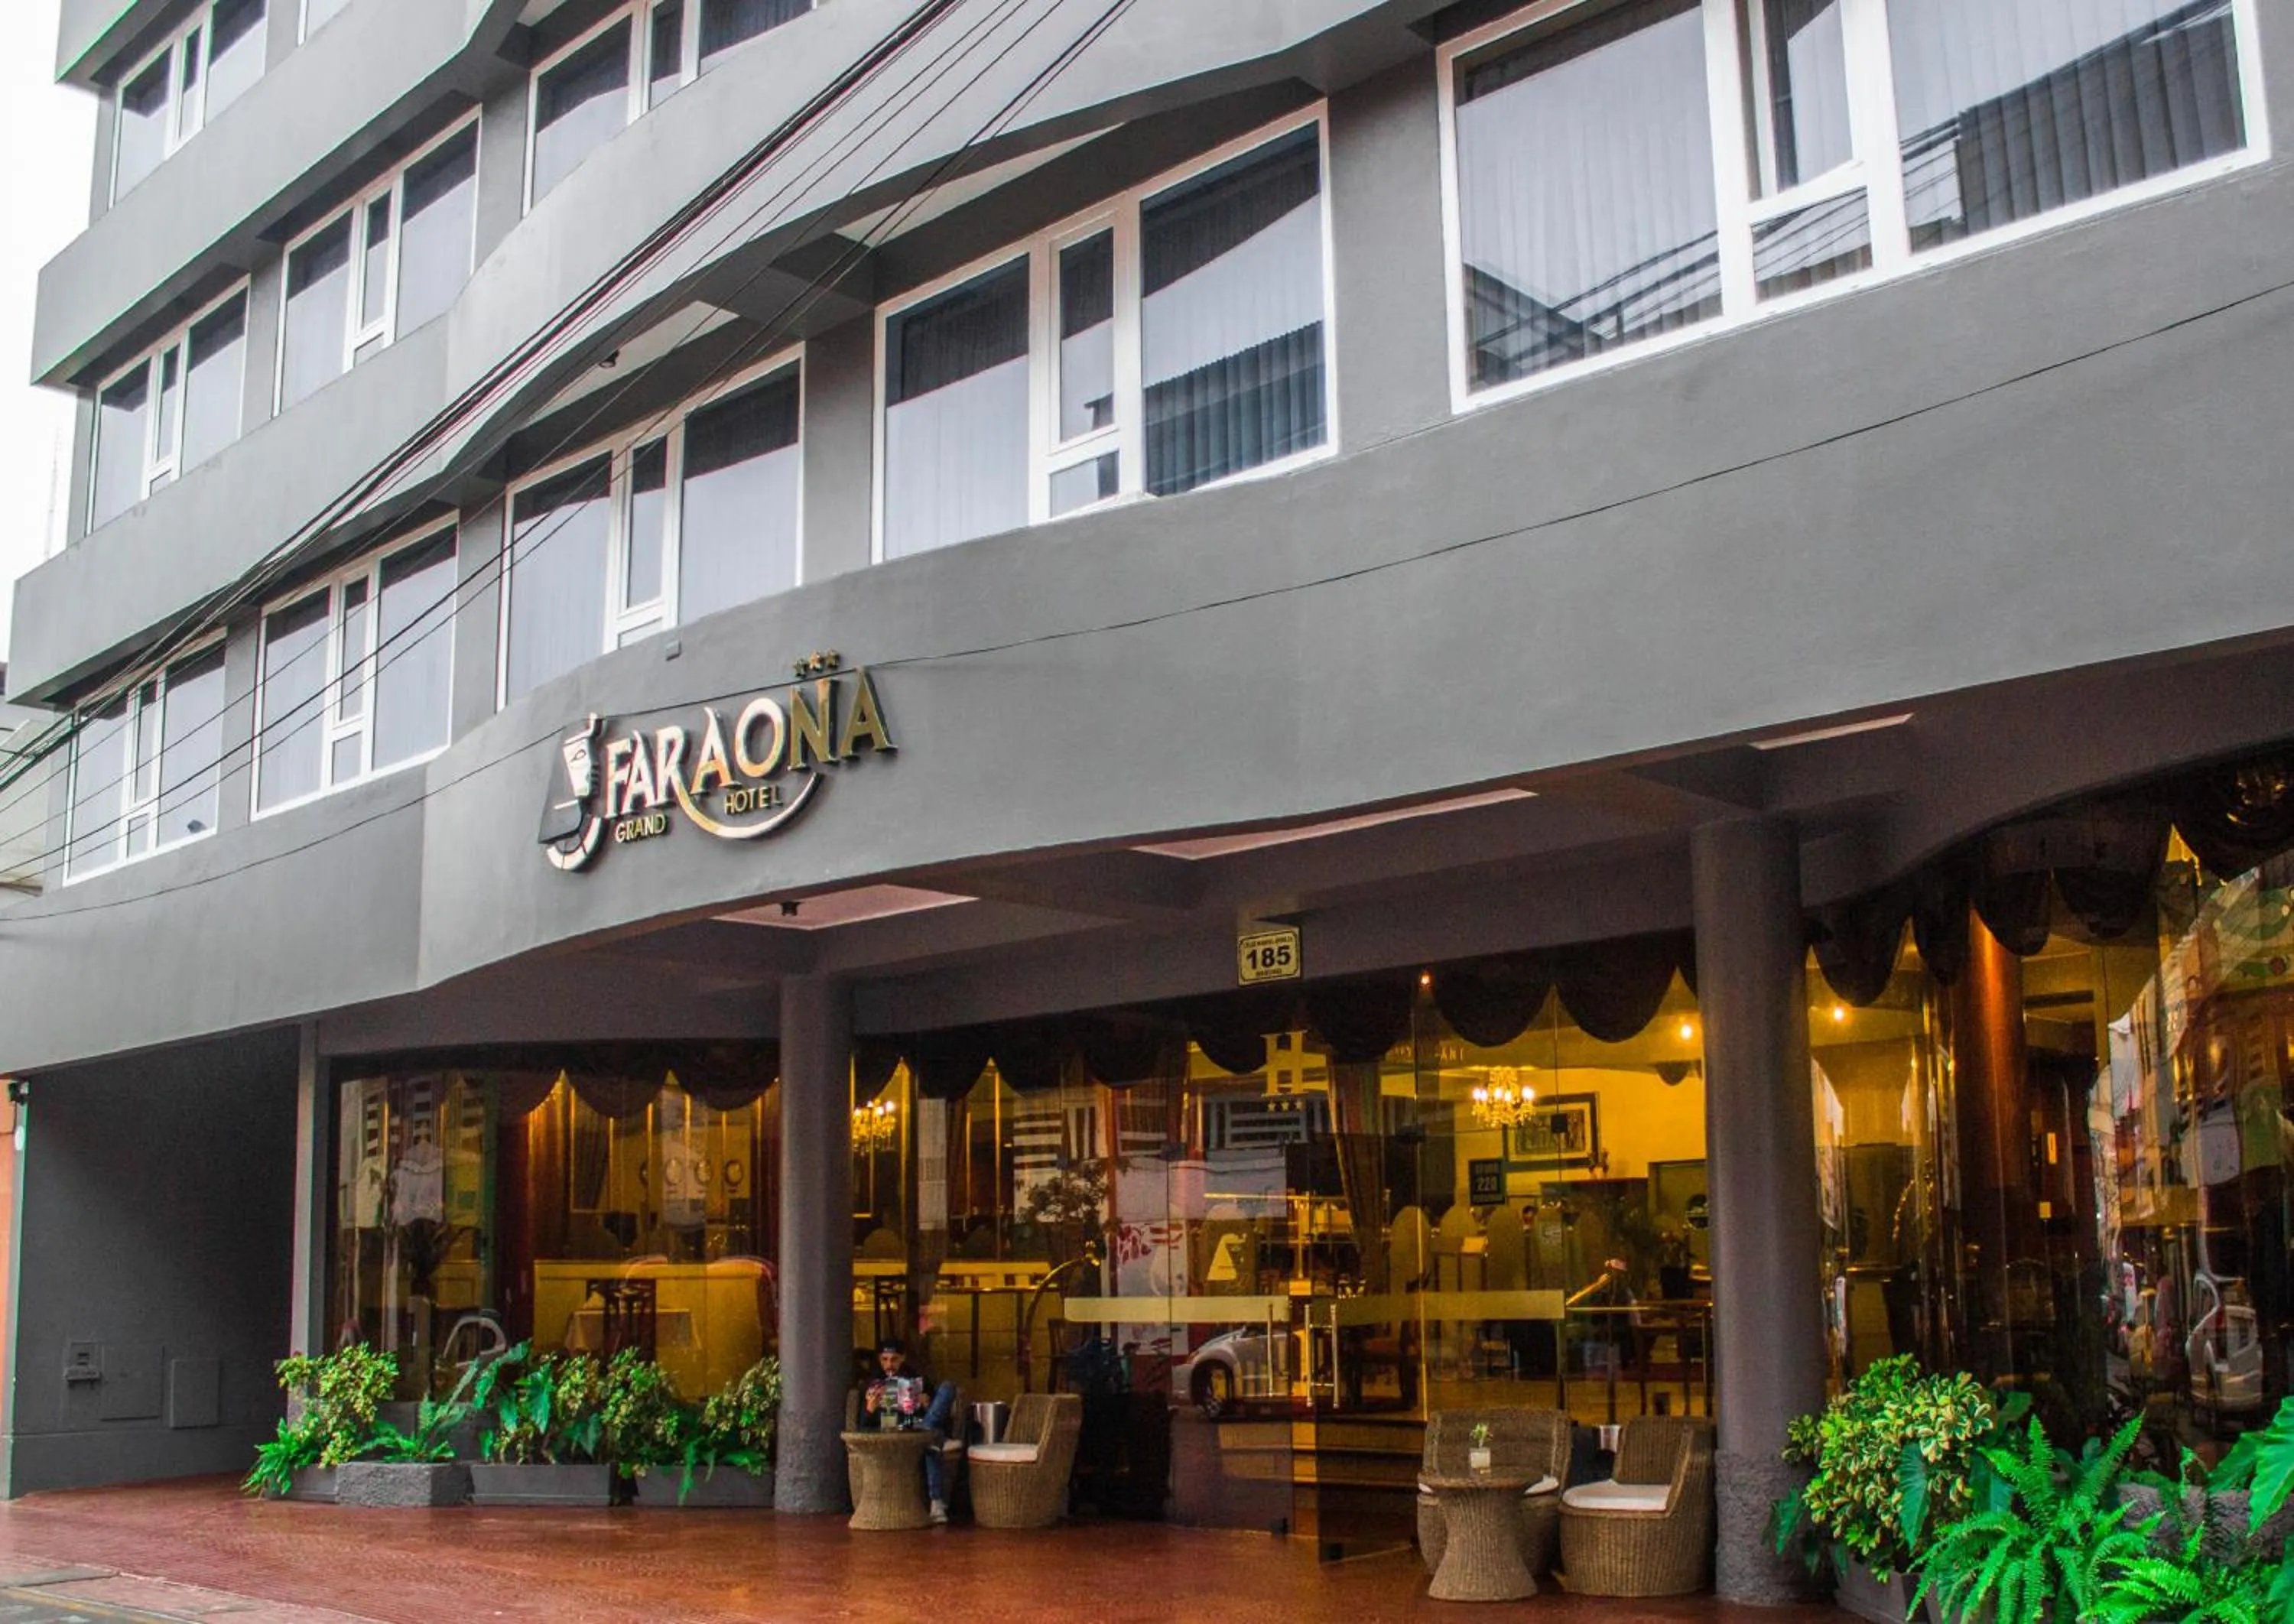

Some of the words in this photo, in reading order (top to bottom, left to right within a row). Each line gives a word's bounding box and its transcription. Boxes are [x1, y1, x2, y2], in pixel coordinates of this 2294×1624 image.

[603, 665, 897, 818] FARAONA
[724, 784, 782, 814] HOTEL
[615, 814, 667, 843] GRAND
[1246, 944, 1290, 970] 185
